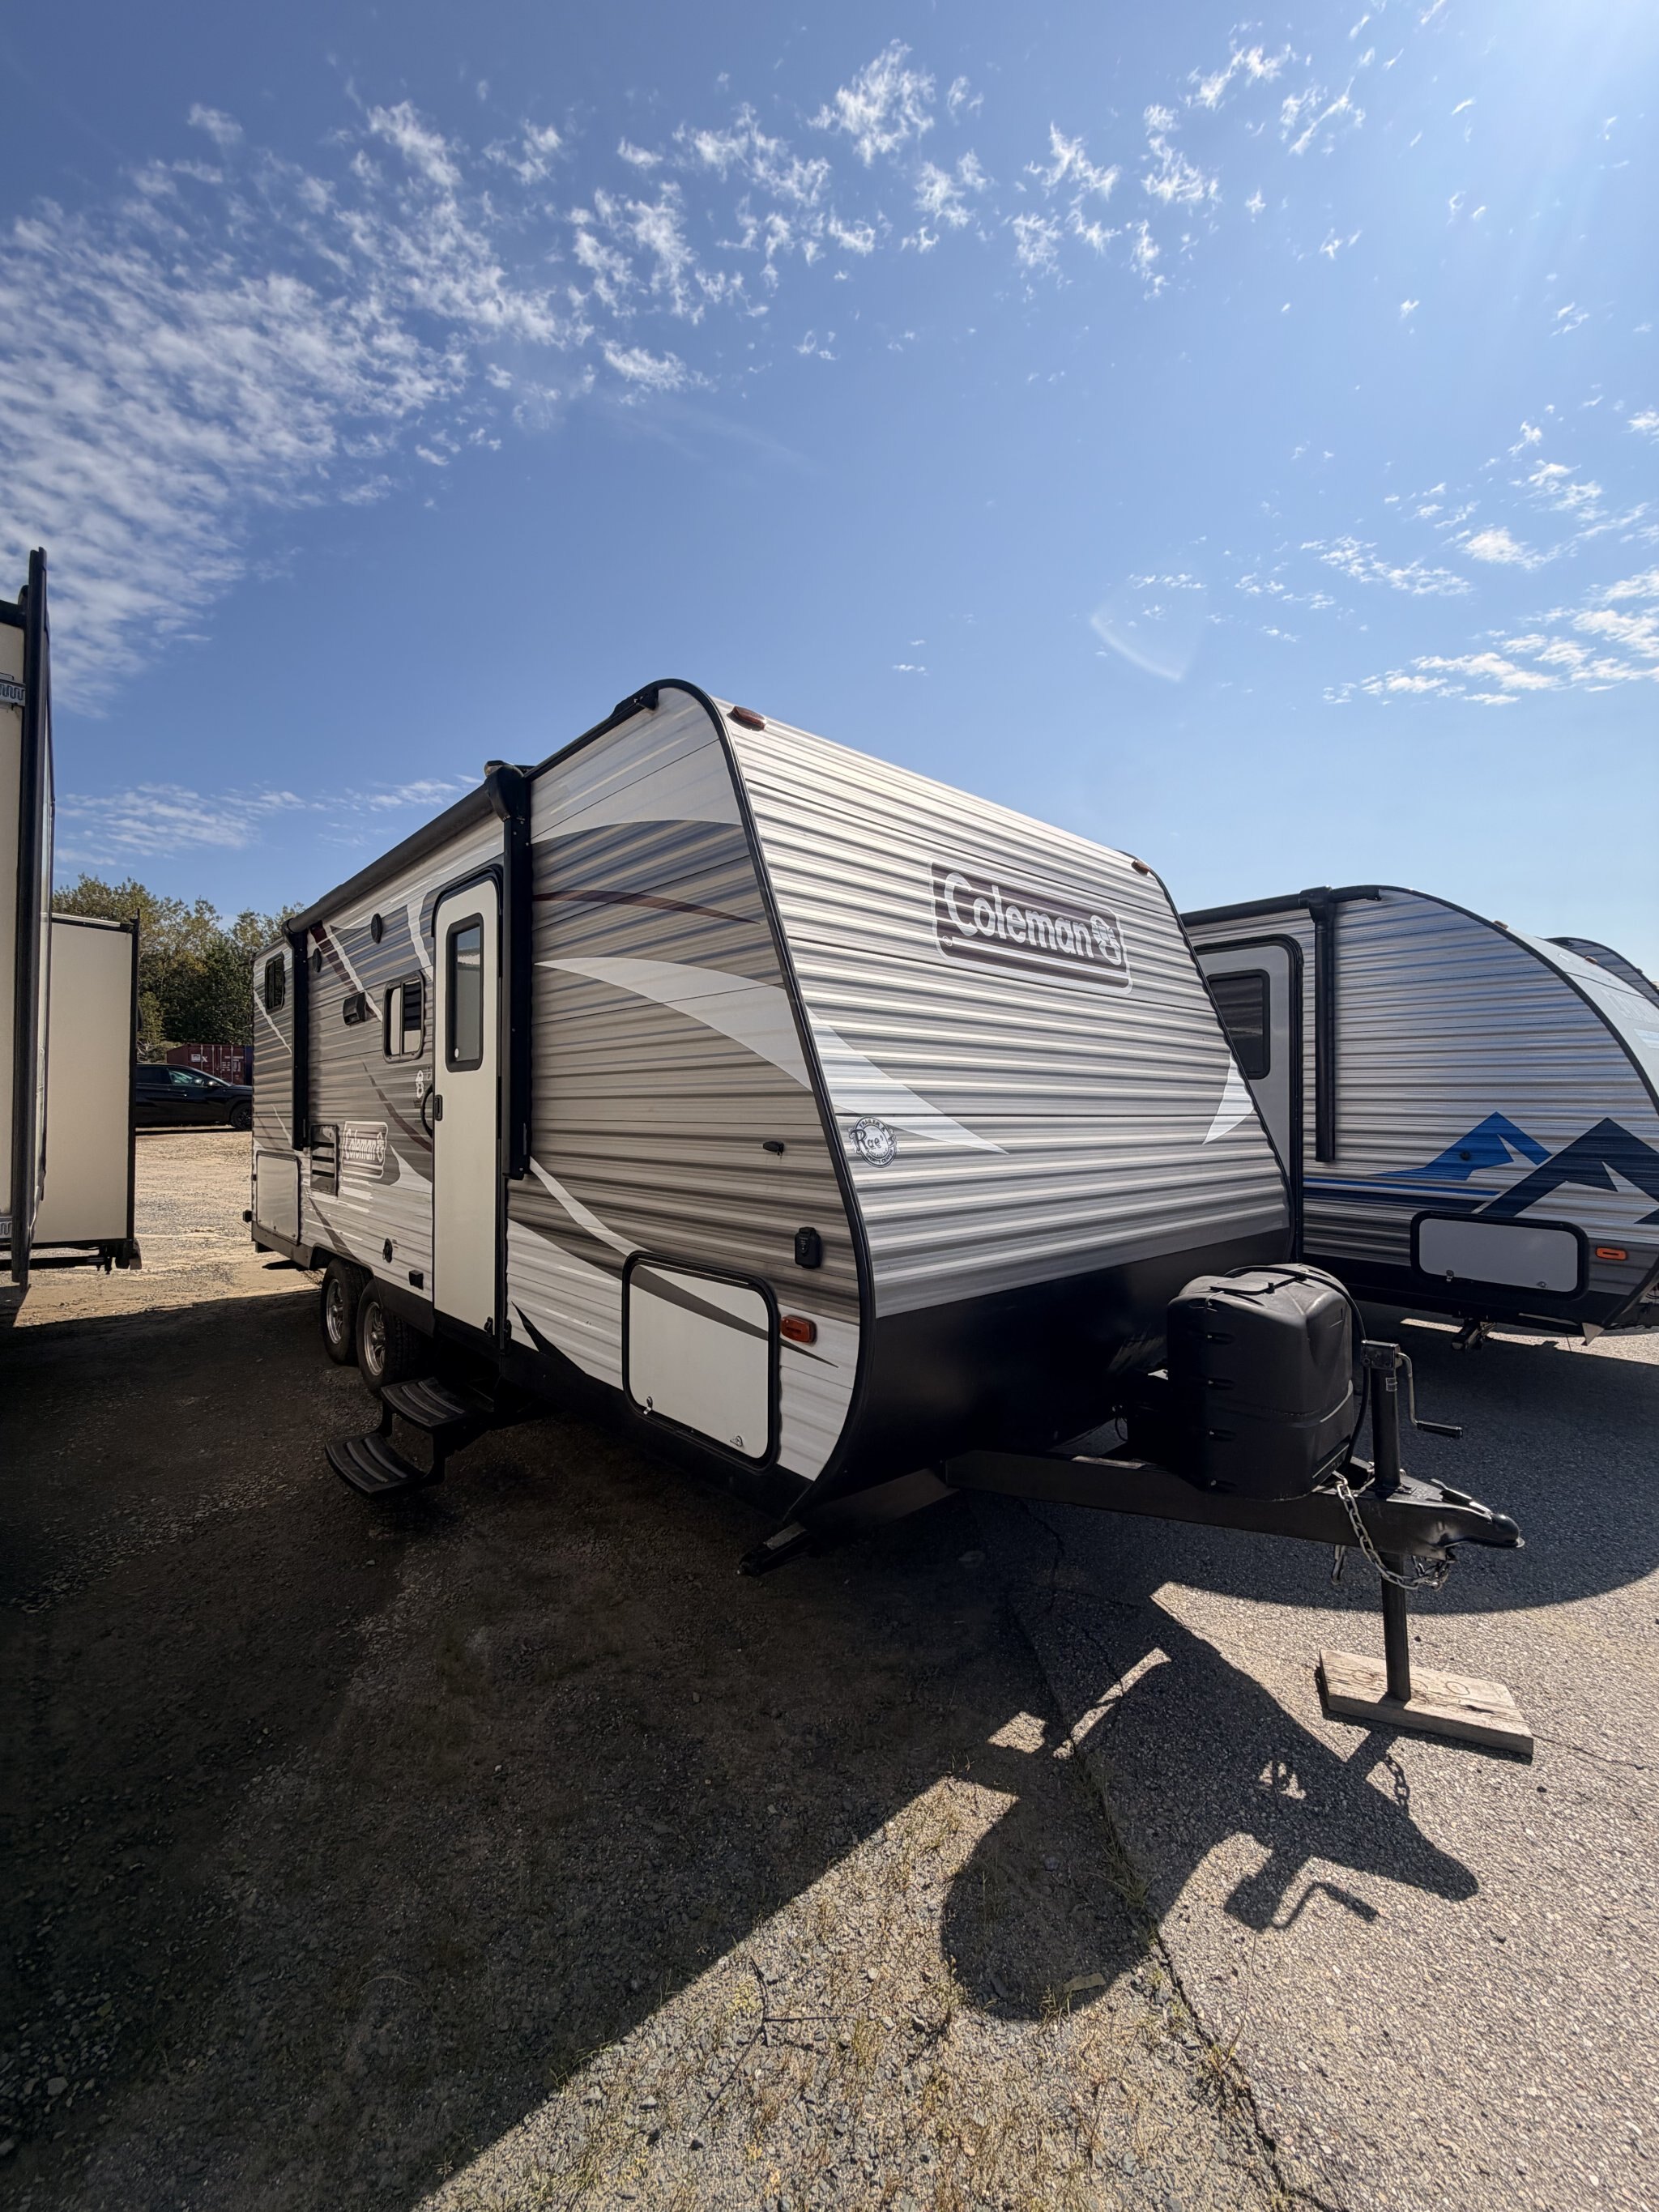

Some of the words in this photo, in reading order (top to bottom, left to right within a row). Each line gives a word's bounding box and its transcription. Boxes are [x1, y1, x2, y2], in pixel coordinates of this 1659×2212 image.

[945, 872, 1095, 958] Coleman
[859, 1119, 881, 1128] TRAILER
[344, 1128, 377, 1160] Coleman
[865, 1152, 881, 1164] SPORTS
